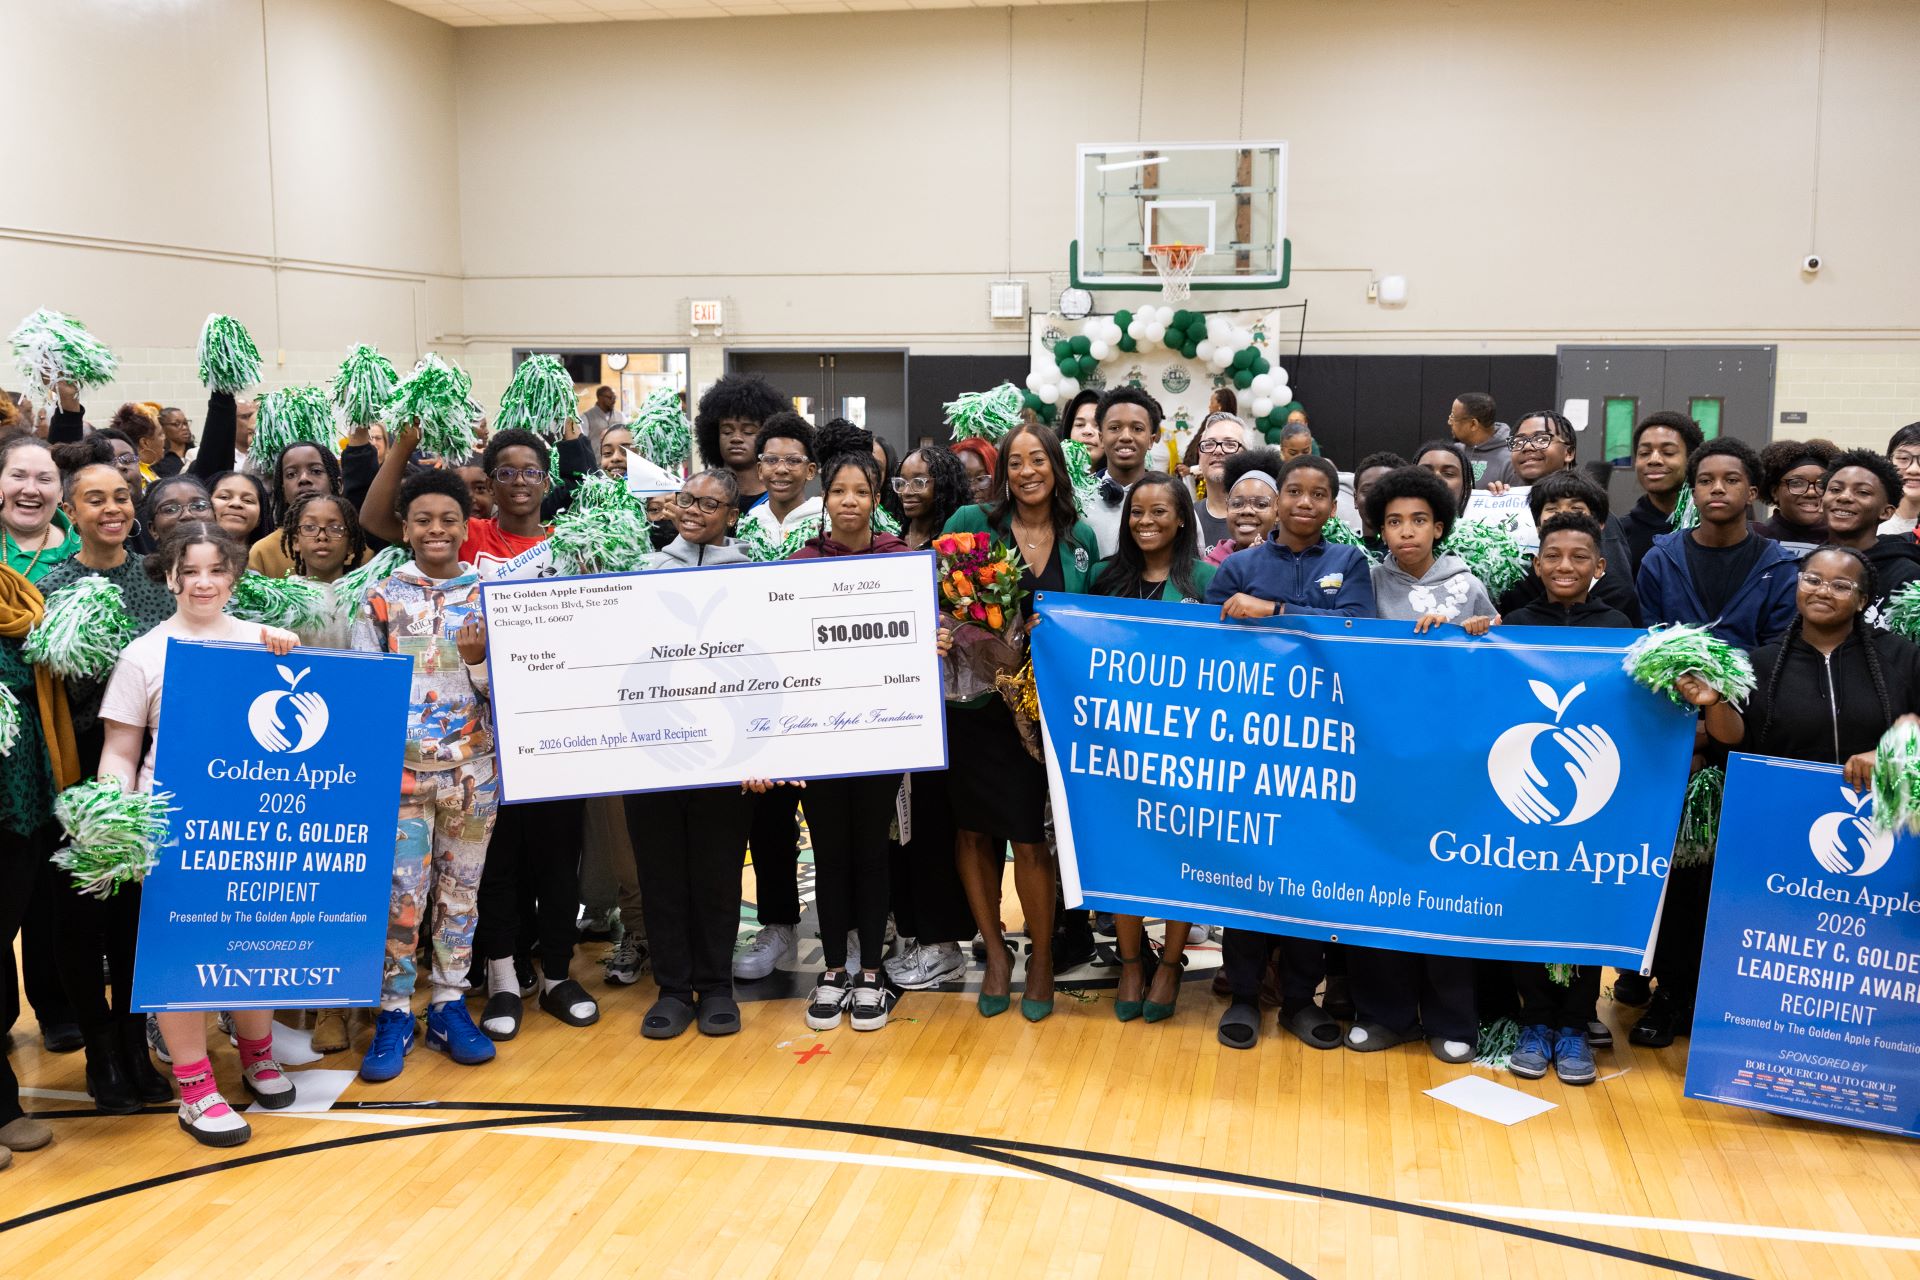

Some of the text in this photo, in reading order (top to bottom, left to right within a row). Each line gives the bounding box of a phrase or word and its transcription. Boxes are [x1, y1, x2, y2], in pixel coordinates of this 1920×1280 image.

[694, 304, 716, 320] EXIT
[1473, 497, 1532, 509] #LeadGo
[491, 584, 633, 601] The Golden Apple Foundation
[768, 580, 881, 602] Date May 2026
[492, 605, 509, 614] 901
[511, 604, 522, 612] W
[523, 601, 559, 614] Jackson
[560, 599, 584, 610] Blvd,
[586, 598, 600, 608] Ste
[602, 598, 619, 606] 205
[494, 614, 574, 628] Chicago, IL 60607
[817, 620, 910, 644] $10,000.00
[510, 651, 556, 663] Pay to the
[527, 642, 744, 672] Order of Nicole Spicer
[617, 674, 920, 701] Ten Thousand and Zero Cents Dollars
[1089, 647, 1344, 705] PROUD HOME OF A
[746, 708, 923, 734] The Golden Apple Foundation
[1073, 695, 1356, 755] STANLEY C. GOLDER
[518, 727, 708, 755] For 2026 Golden Apple Award Recipient
[207, 758, 357, 789] Golden Apple
[1070, 741, 1357, 804] LEADERSHIP AWARD
[259, 793, 306, 814] 2026
[184, 820, 369, 844] STANLEY C. GOLDER
[1137, 798, 1281, 846] RECIPIENT
[180, 850, 367, 873] LEADERSHIP AWARD
[1429, 830, 1668, 885] Golden Apple
[226, 881, 320, 903] RECIPIENT
[1180, 862, 1503, 917] Presented by The Golden Apple Foundation
[1766, 873, 1920, 917] Golden Apple
[169, 911, 367, 925] Presented by The Golden Apple Foundation
[1816, 912, 1866, 937] 2026
[226, 940, 314, 951] SPONSORED BY
[1741, 928, 1920, 974] STANLEY C. GOLDE
[195, 964, 341, 987] WINTRUST
[1737, 956, 1854, 992] LEADERSHIP
[1780, 993, 1878, 1026] RECIPIENT
[1724, 1012, 1920, 1054] Presented by The Golden Apple Foundatio
[1778, 1049, 1869, 1073] SPONSORED BY
[1745, 1059, 1897, 1093] BOB LOQUERCIO AUTO GROUP
